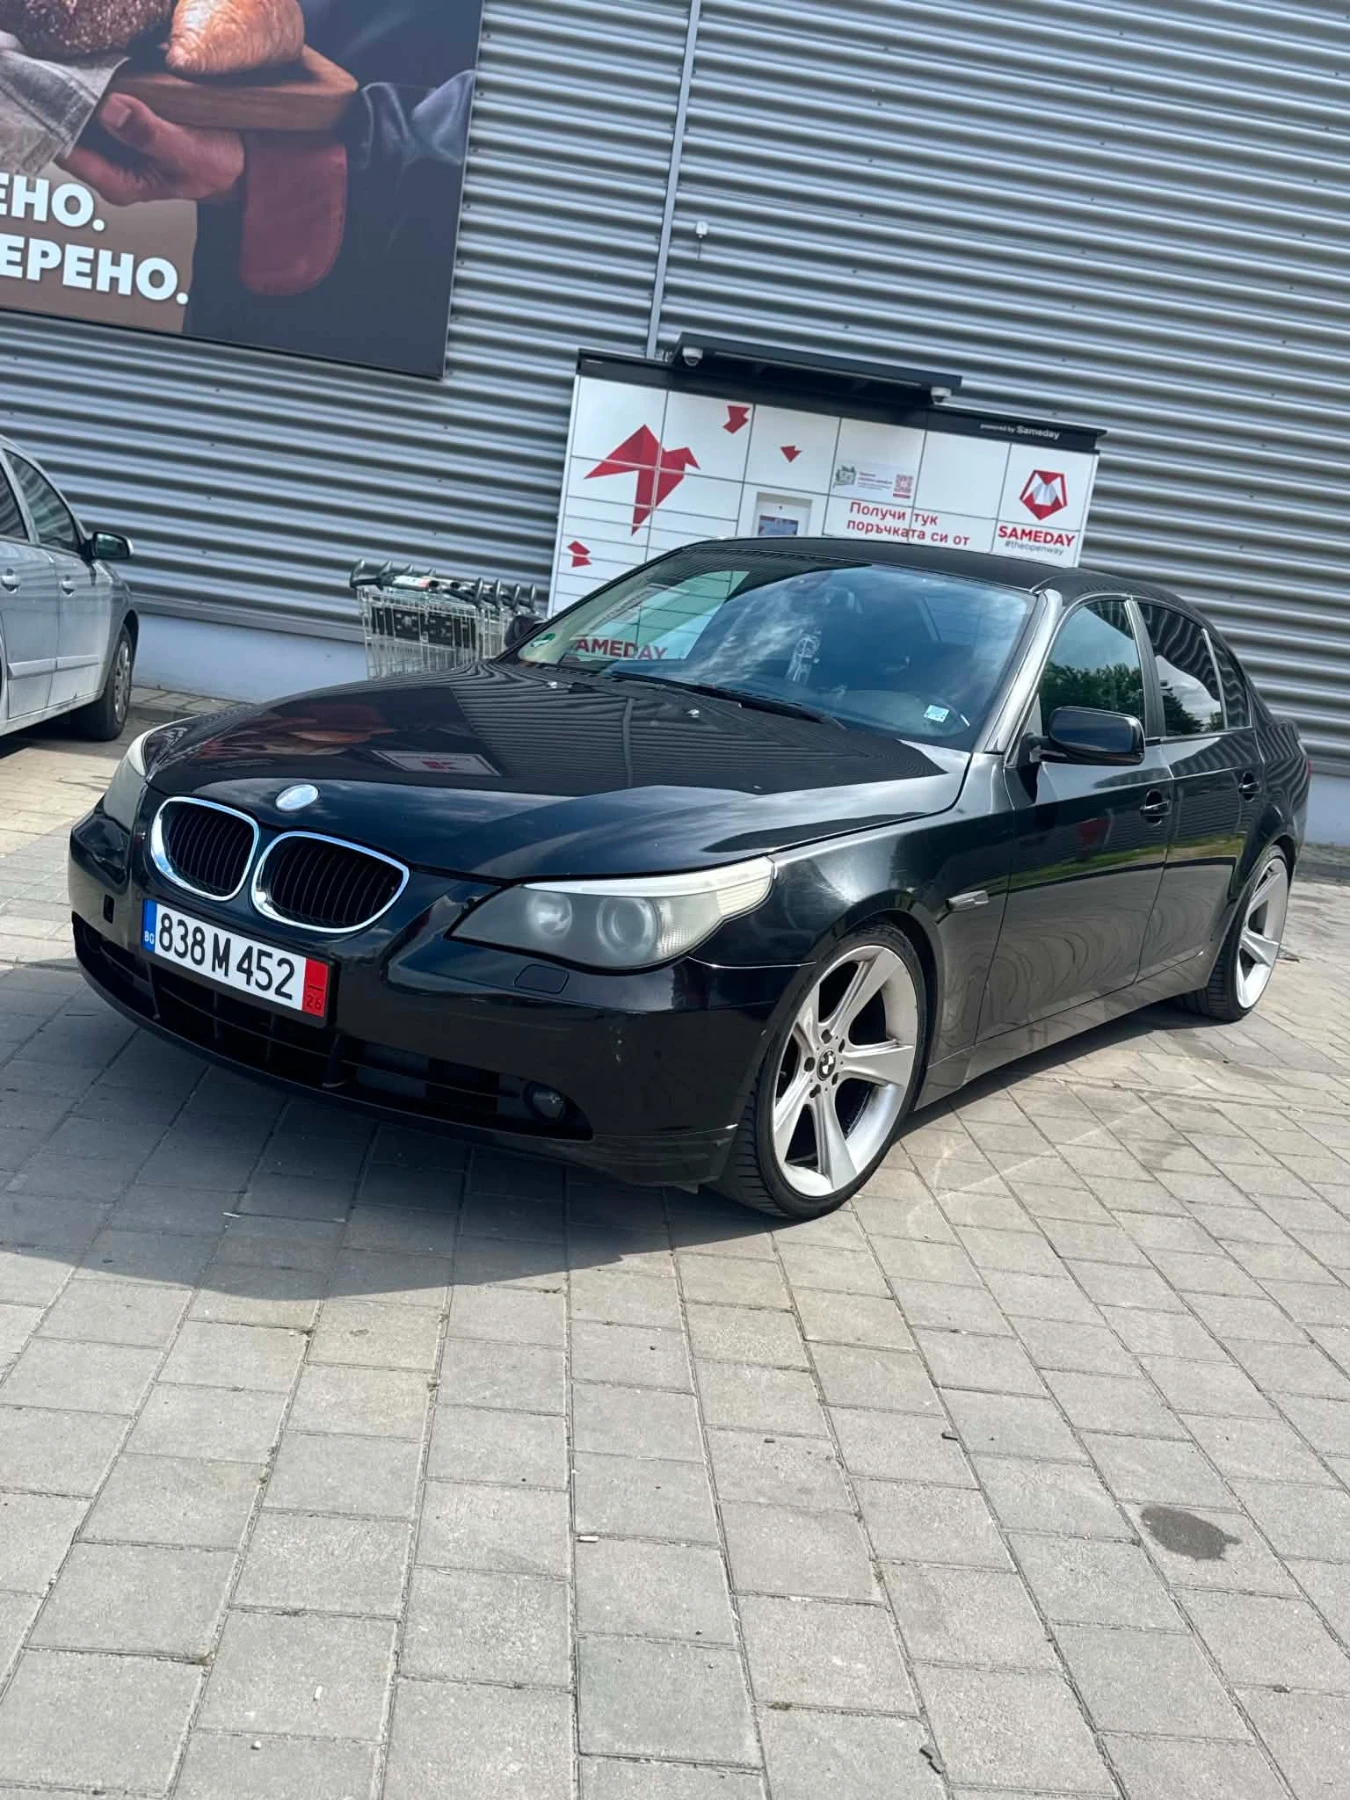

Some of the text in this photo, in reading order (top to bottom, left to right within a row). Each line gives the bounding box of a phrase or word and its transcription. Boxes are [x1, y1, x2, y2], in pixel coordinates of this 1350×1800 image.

[1016, 425, 1060, 441] Sameday
[849, 501, 938, 526] Получи тук
[847, 519, 970, 546] поръчката си от
[998, 525, 1076, 547] SAMEDAY
[144, 930, 155, 945] BG
[158, 912, 296, 1001] 838 M 452
